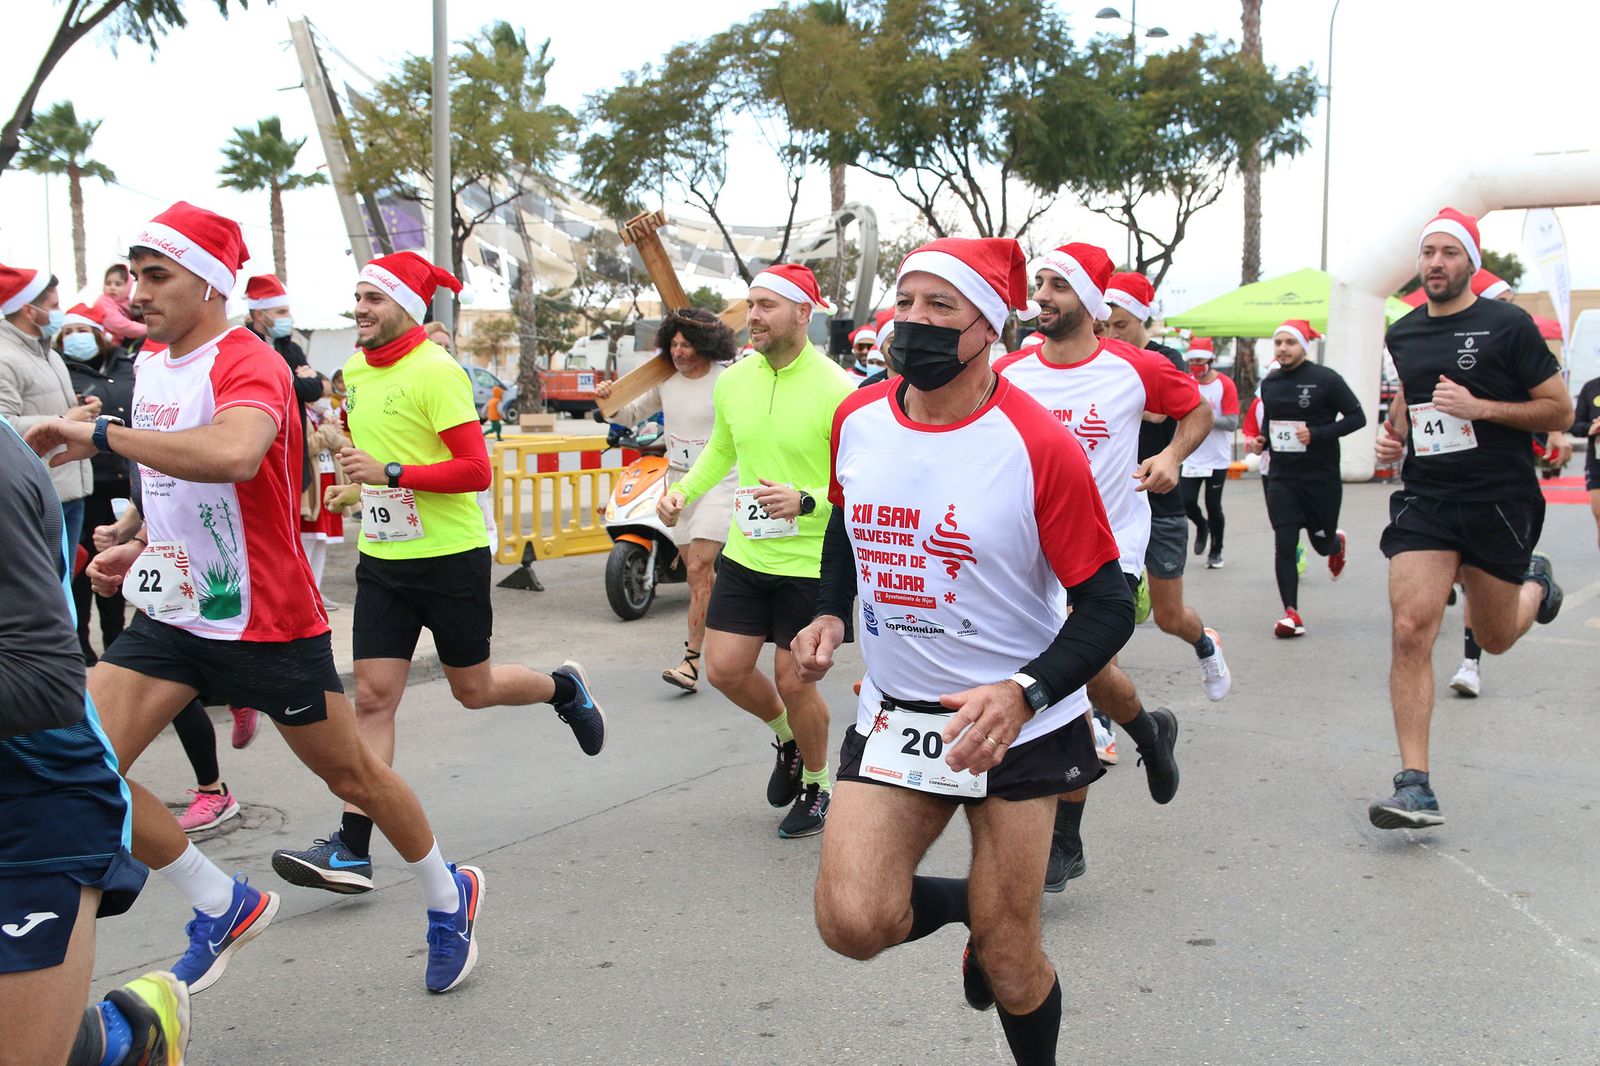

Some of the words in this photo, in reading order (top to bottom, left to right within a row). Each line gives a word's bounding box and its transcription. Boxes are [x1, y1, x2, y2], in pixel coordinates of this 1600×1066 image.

[626, 212, 663, 242] INRI
[1277, 432, 1291, 441] 45
[1424, 419, 1444, 436] 41
[683, 449, 689, 458] 1
[370, 506, 391, 523] 19
[851, 504, 872, 523] XII
[877, 505, 920, 529] SAN
[853, 528, 914, 547] SILVESTRE
[857, 547, 906, 567] COMARCA
[910, 554, 926, 569] DE
[138, 569, 162, 592] 22
[877, 569, 925, 592] NÍJAR
[885, 622, 945, 634] COPROHNÍJAR
[901, 727, 943, 759] 20
